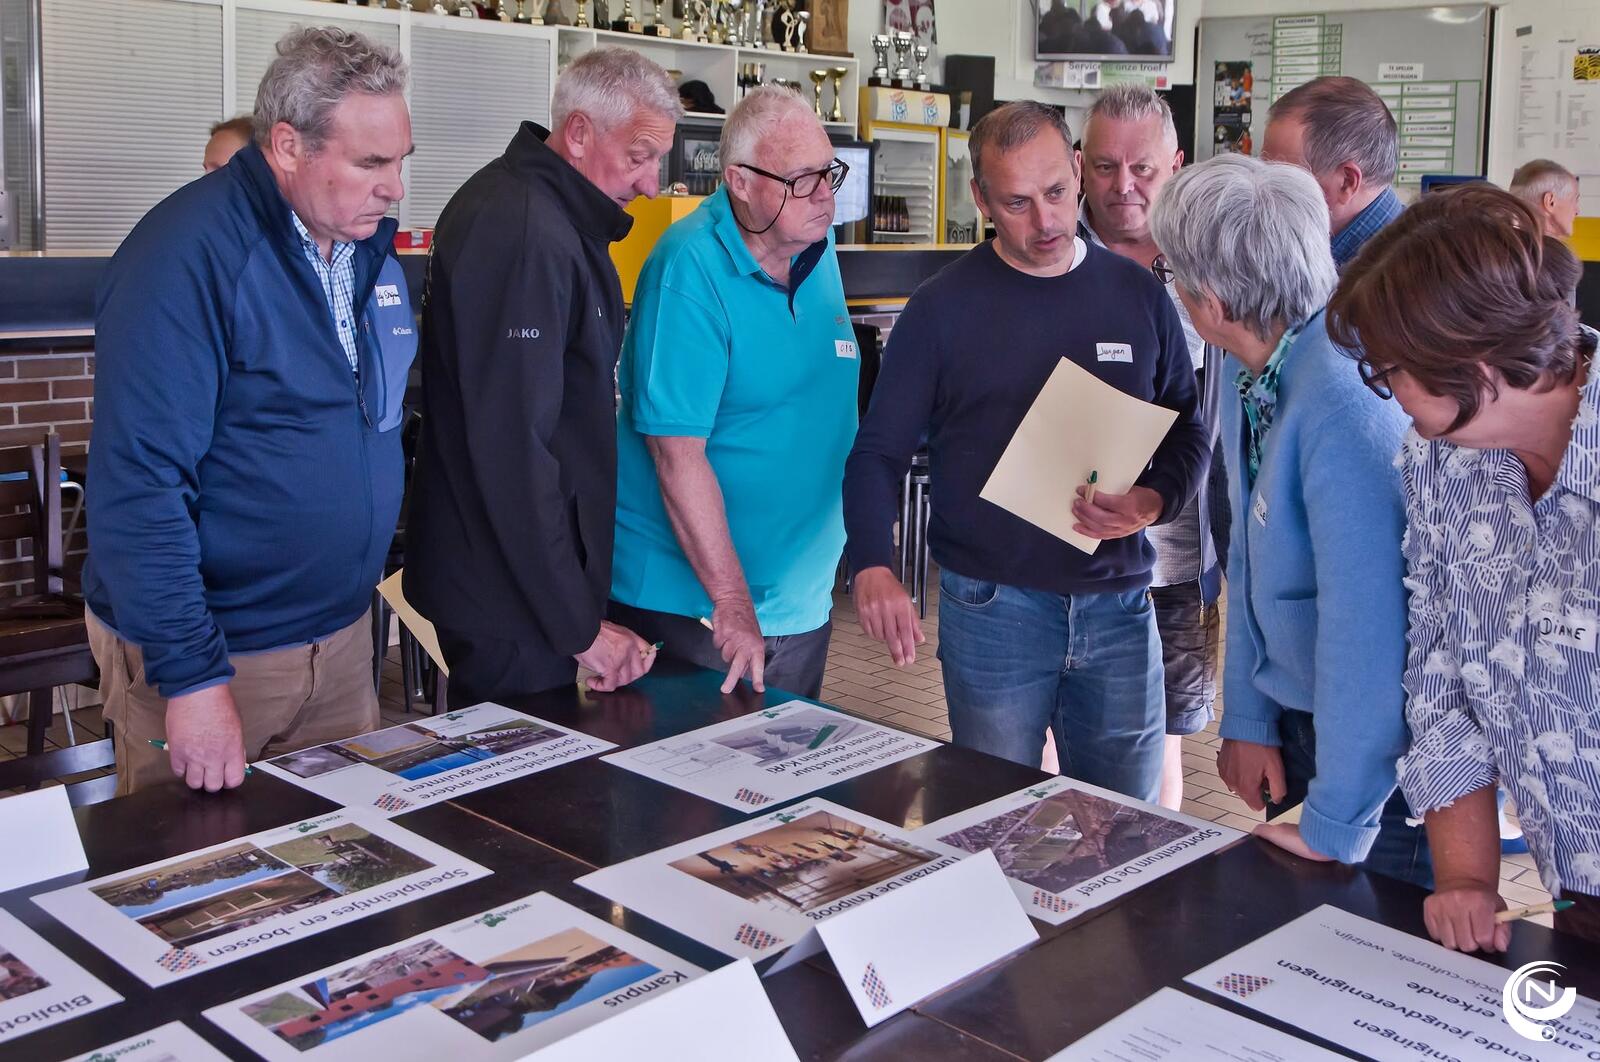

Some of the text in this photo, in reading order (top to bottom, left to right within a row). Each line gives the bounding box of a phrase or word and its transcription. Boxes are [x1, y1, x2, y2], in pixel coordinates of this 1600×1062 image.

[1116, 63, 1138, 71] onze
[507, 328, 540, 338] JAKO
[524, 750, 539, 759] &
[541, 737, 582, 753] sport-
[791, 736, 905, 777] sportinfrastructuur
[799, 744, 846, 765] domein
[848, 730, 890, 747] binnen
[403, 756, 524, 793] beweegruimten
[419, 743, 600, 800] Voorbeelden van andere
[827, 740, 926, 776] Plannen nieuwe
[1076, 828, 1222, 897] Sportcentrum De Dreef
[333, 868, 469, 917] Speelpleintjes
[805, 890, 880, 921] Knipoog
[299, 914, 328, 926] en
[1334, 928, 1385, 952] welzijn,
[603, 970, 689, 1007] Kampus
[1392, 950, 1503, 995] ocio-culturele,
[1276, 958, 1541, 1062] ende jeugdverenigingen
[1407, 981, 1496, 1018] erkende
[1353, 1018, 1462, 1062] enigingen
